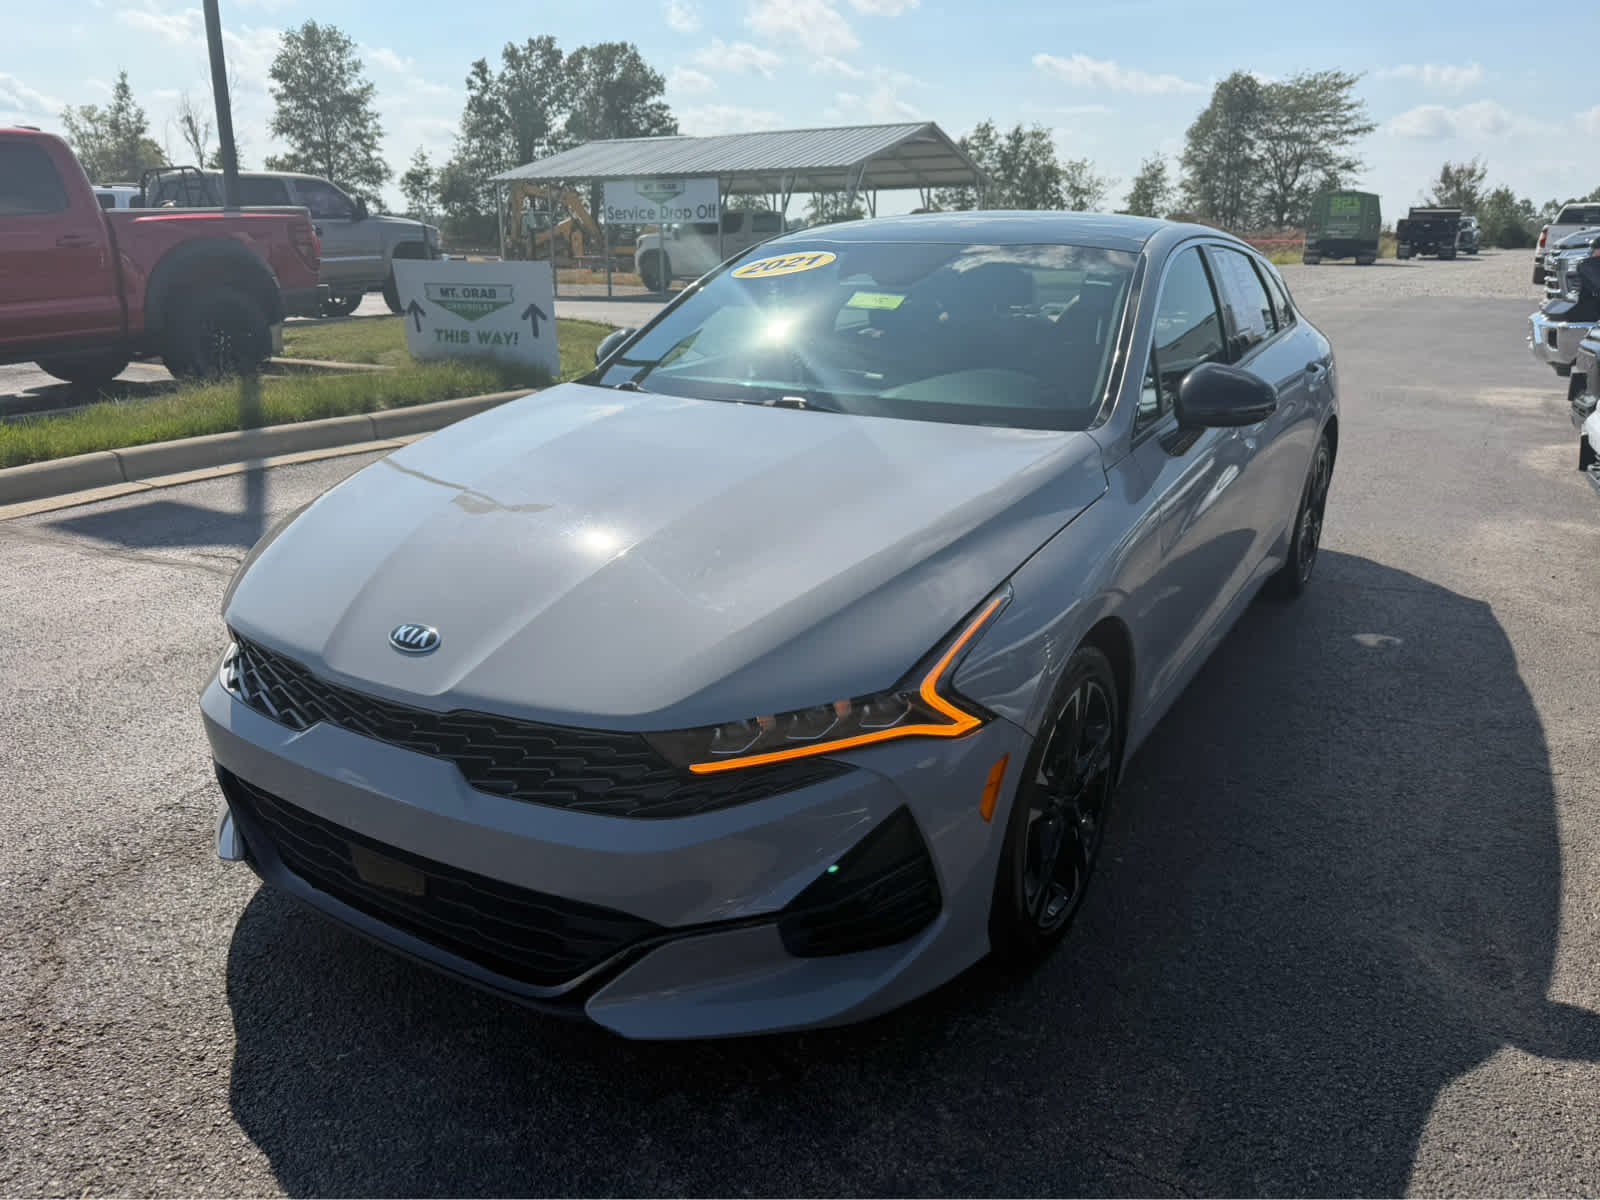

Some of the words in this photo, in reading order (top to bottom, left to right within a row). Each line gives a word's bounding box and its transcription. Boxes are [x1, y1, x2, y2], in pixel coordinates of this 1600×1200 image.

[607, 206, 656, 220] Service
[660, 206, 692, 221] Drop
[696, 204, 717, 219] Off
[743, 254, 824, 275] 2021
[440, 287, 458, 297] MT.
[462, 287, 497, 299] ORAB
[434, 328, 470, 344] THIS
[477, 330, 519, 345] WAY!
[393, 625, 430, 647] KIA
